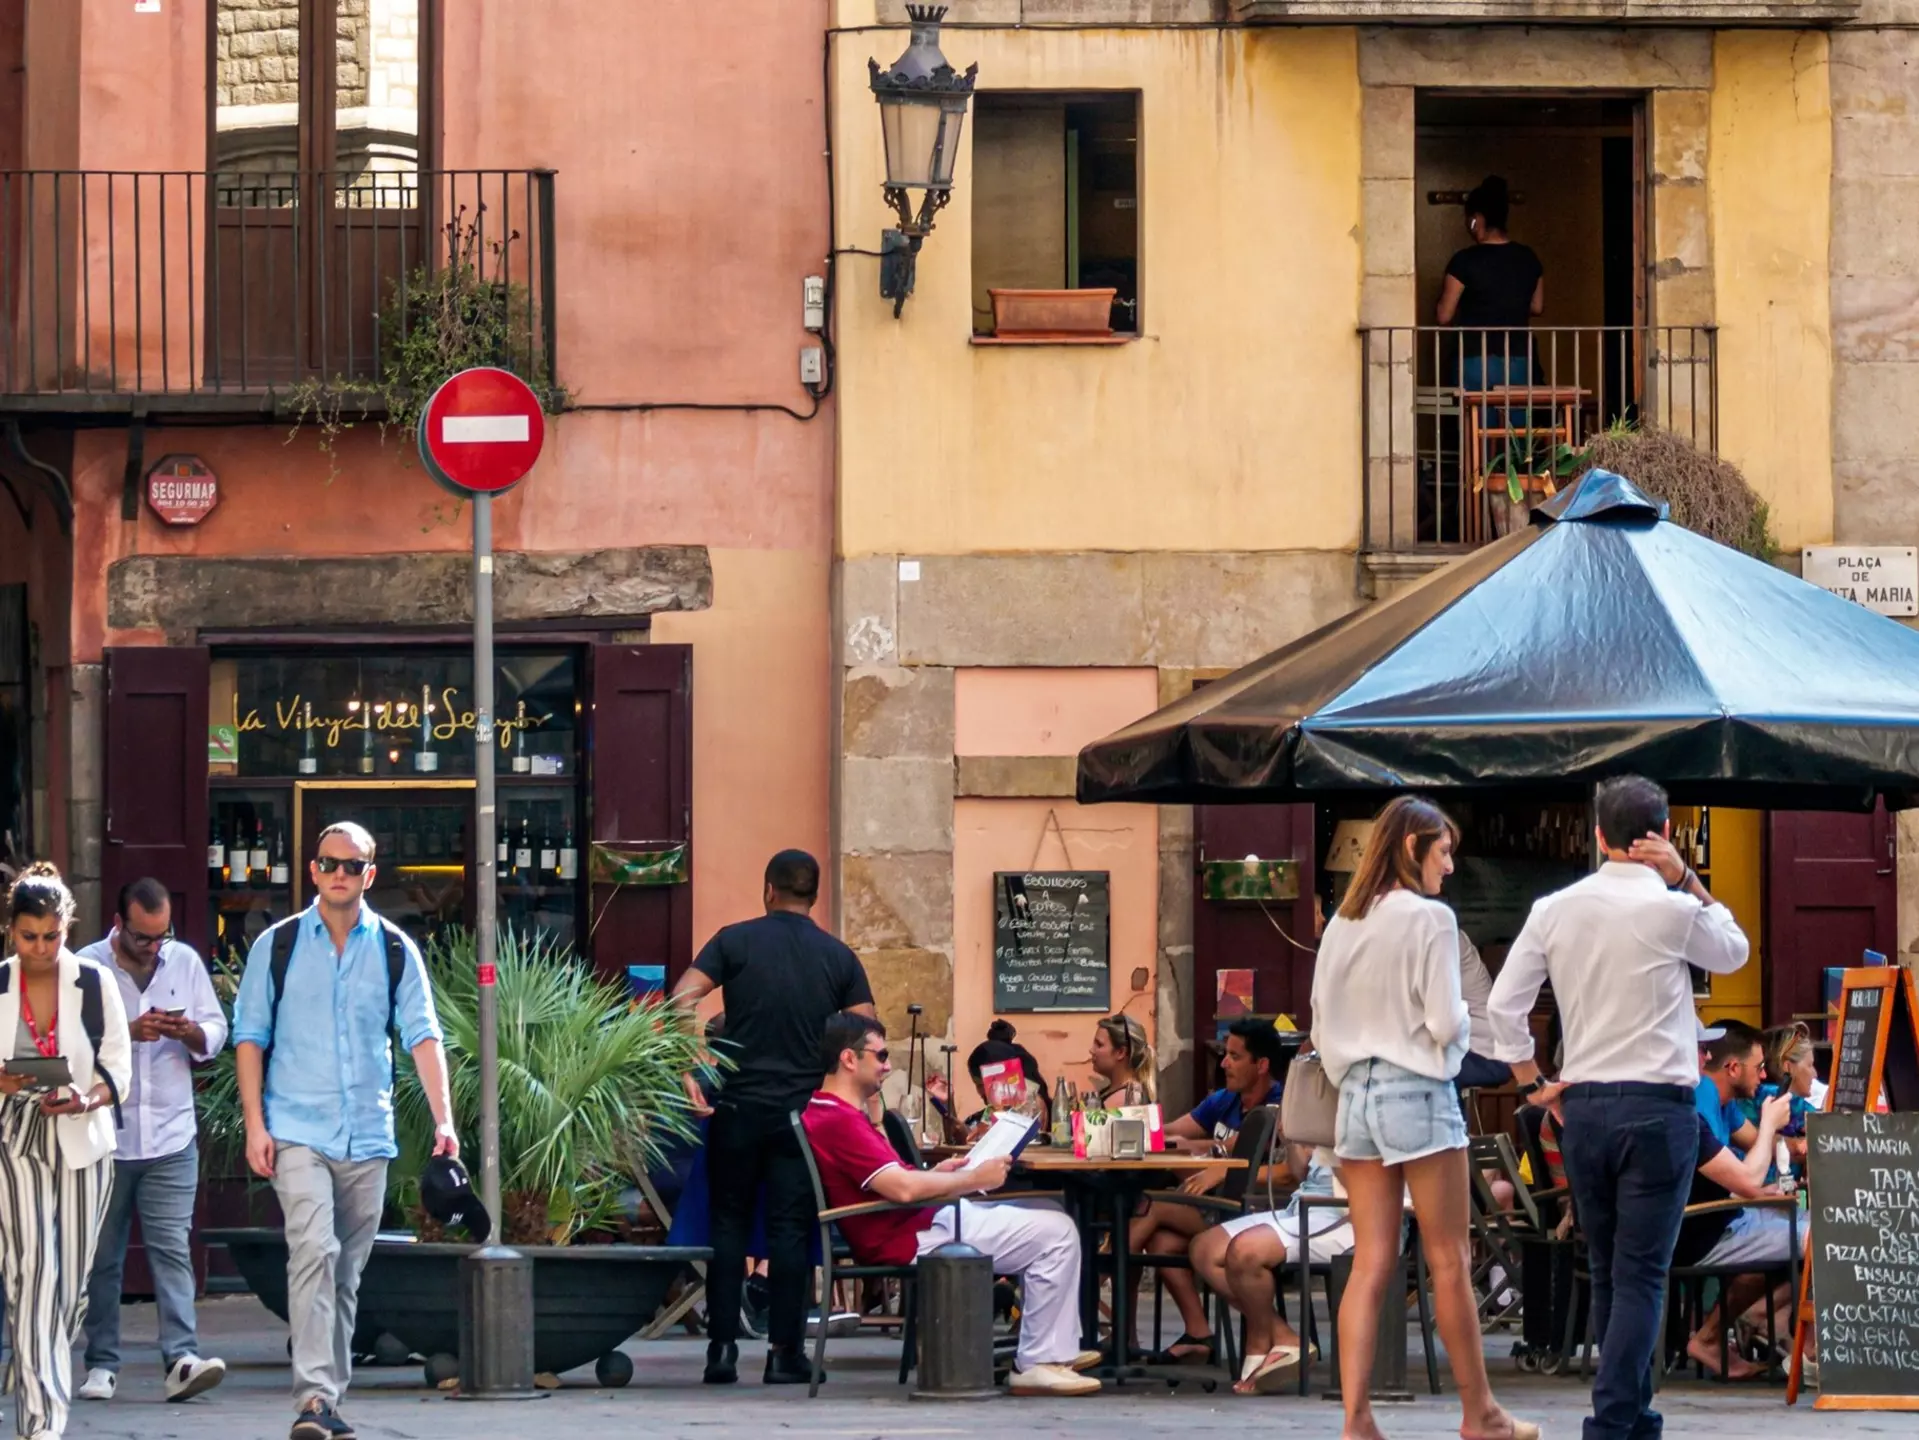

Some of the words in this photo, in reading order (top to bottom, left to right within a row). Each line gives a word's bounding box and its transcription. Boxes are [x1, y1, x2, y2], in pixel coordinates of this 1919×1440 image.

[151, 482, 216, 499] SEGURMAP
[1838, 557, 1882, 569] PLAÇA
[1852, 572, 1870, 582] DE
[1866, 587, 1913, 602] MARIA
[276, 694, 365, 747] Vinya
[377, 700, 422, 729] del
[1817, 1134, 1863, 1154] SANTA
[1866, 1137, 1912, 1156] MARIA
[1823, 1206, 1892, 1229] CARNES
[1825, 1243, 1868, 1262] PIZZA
